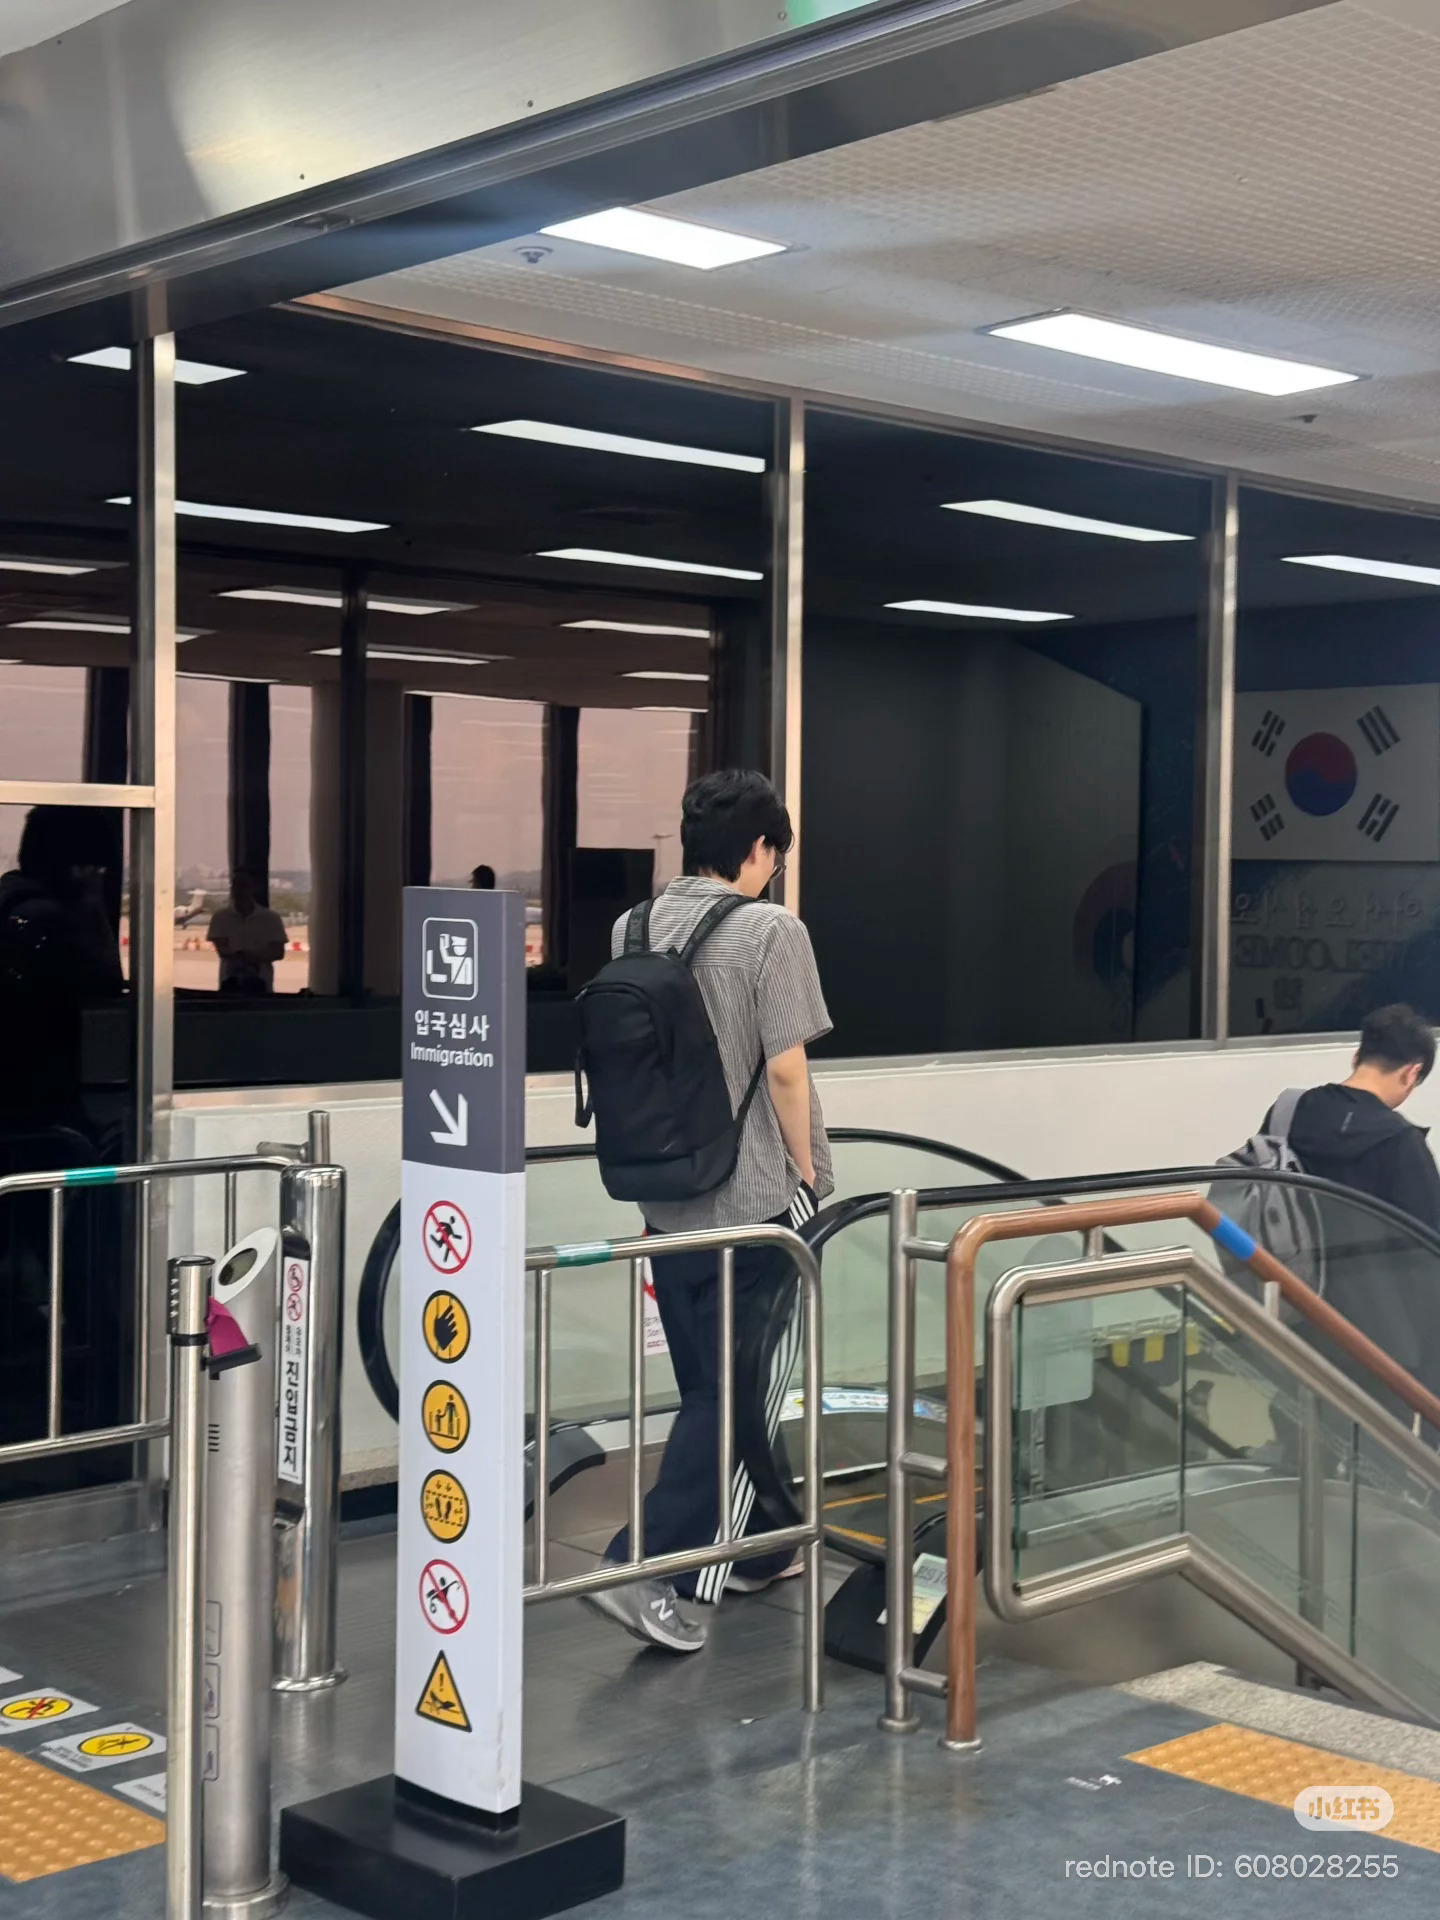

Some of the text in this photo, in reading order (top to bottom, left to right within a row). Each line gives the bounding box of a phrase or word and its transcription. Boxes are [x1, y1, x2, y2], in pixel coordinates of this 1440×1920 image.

[414, 1009, 490, 1042] 입국심사
[410, 1041, 494, 1068] Immigration
[283, 1361, 300, 1473] 진입금지
